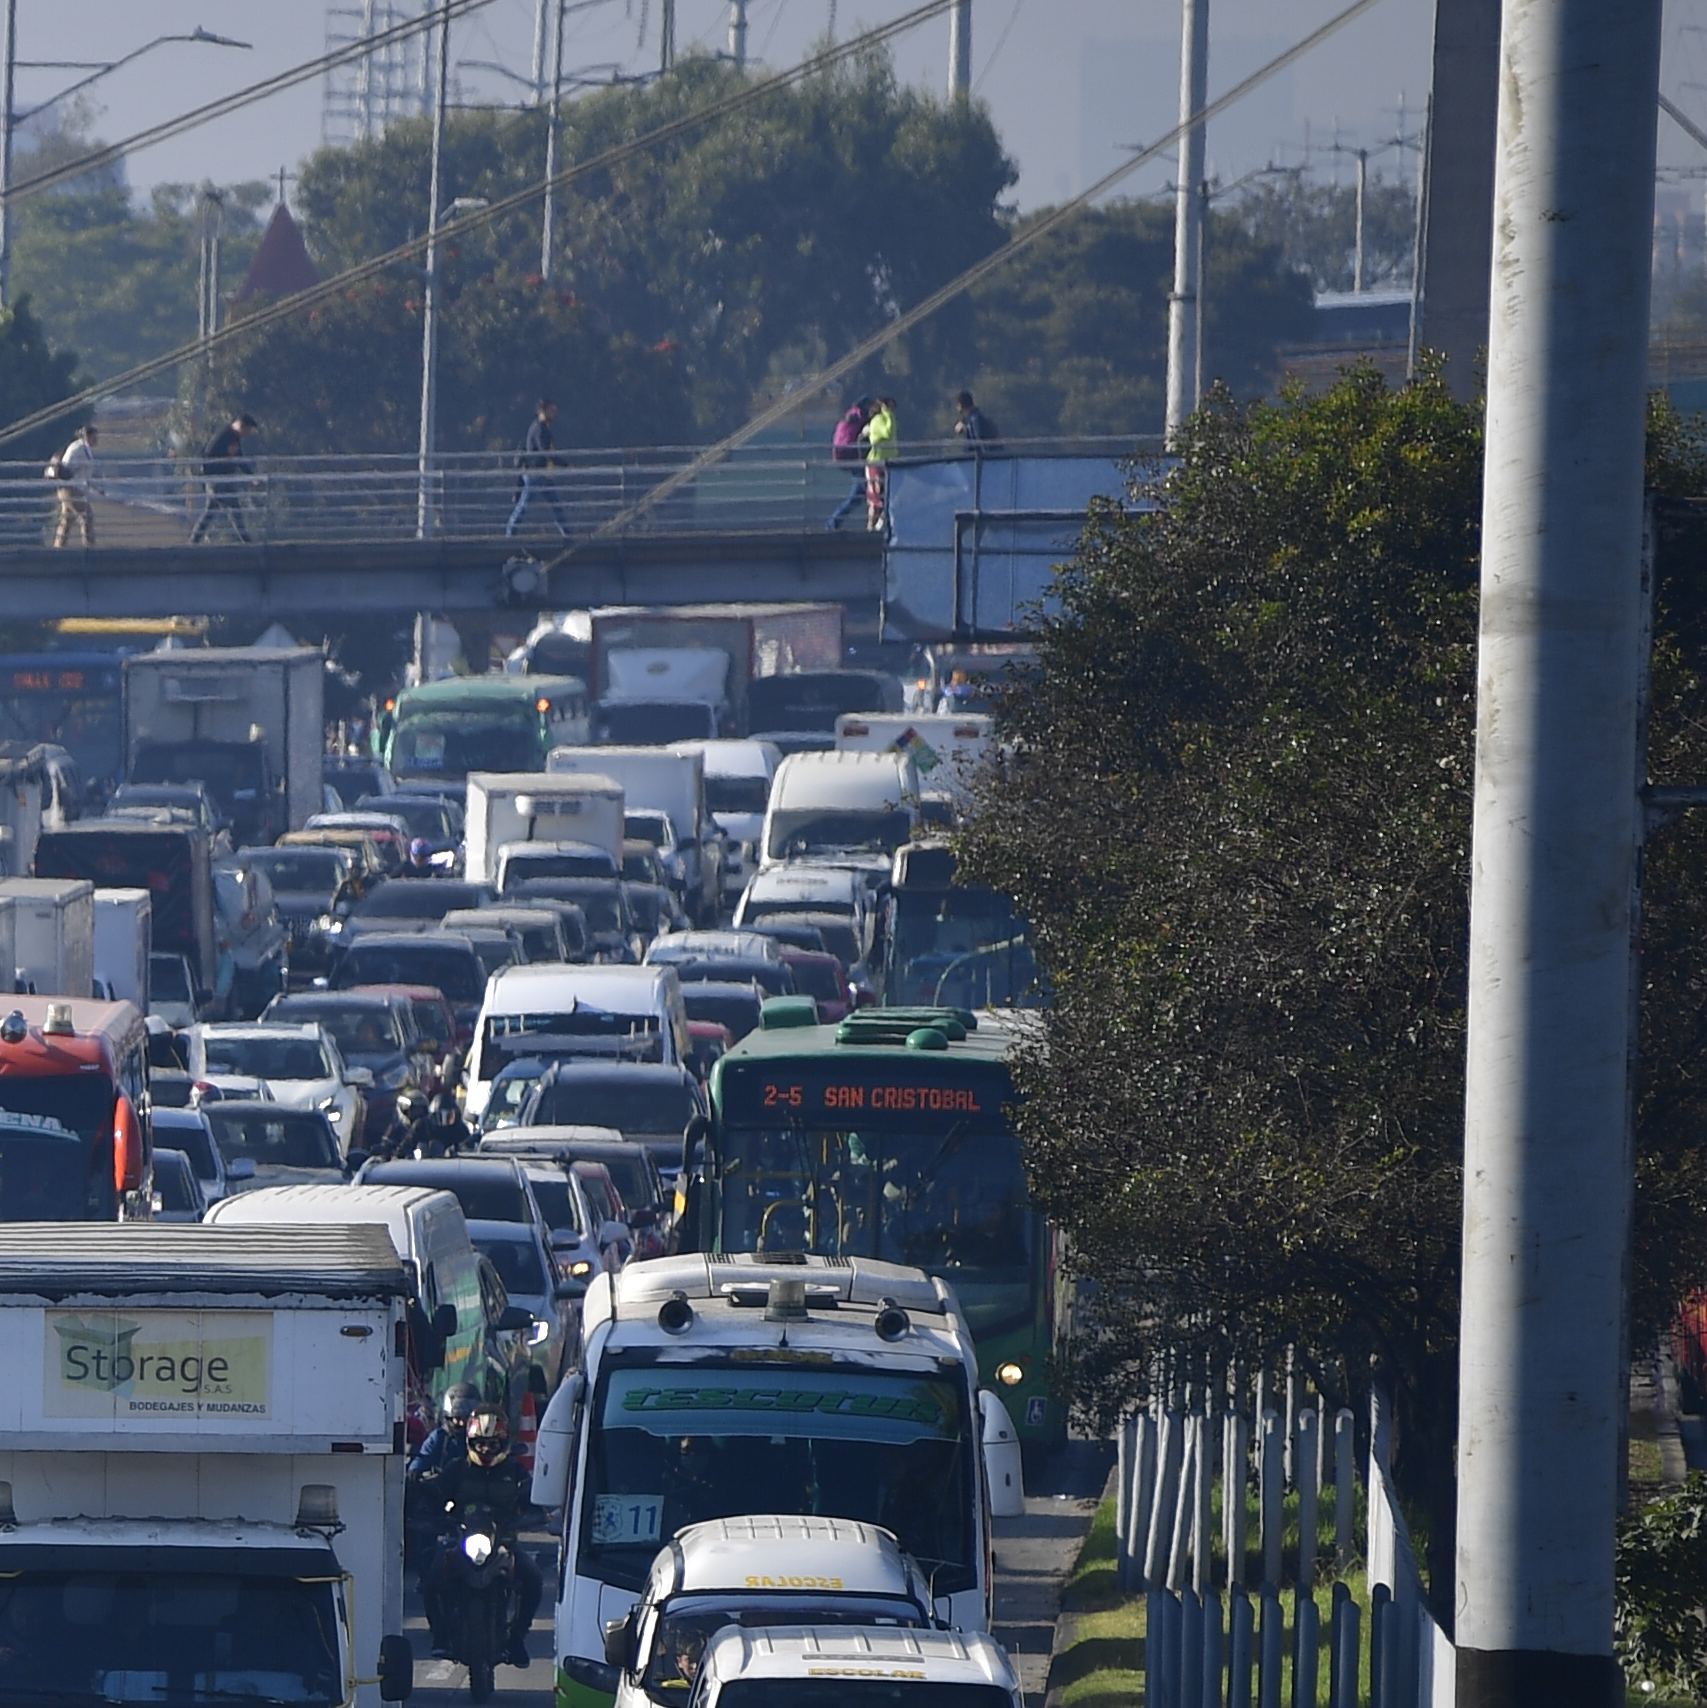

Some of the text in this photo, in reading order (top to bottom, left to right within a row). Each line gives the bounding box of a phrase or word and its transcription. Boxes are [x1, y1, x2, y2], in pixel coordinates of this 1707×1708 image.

[764, 1085, 981, 1112] 2-5 SAN CRISTOBAL
[66, 1345, 230, 1393] Storage
[129, 1402, 267, 1414] BODEGAJES Y MUDANZAS
[630, 1506, 658, 1535] 11
[808, 1667, 929, 1680] ESCOLAR
